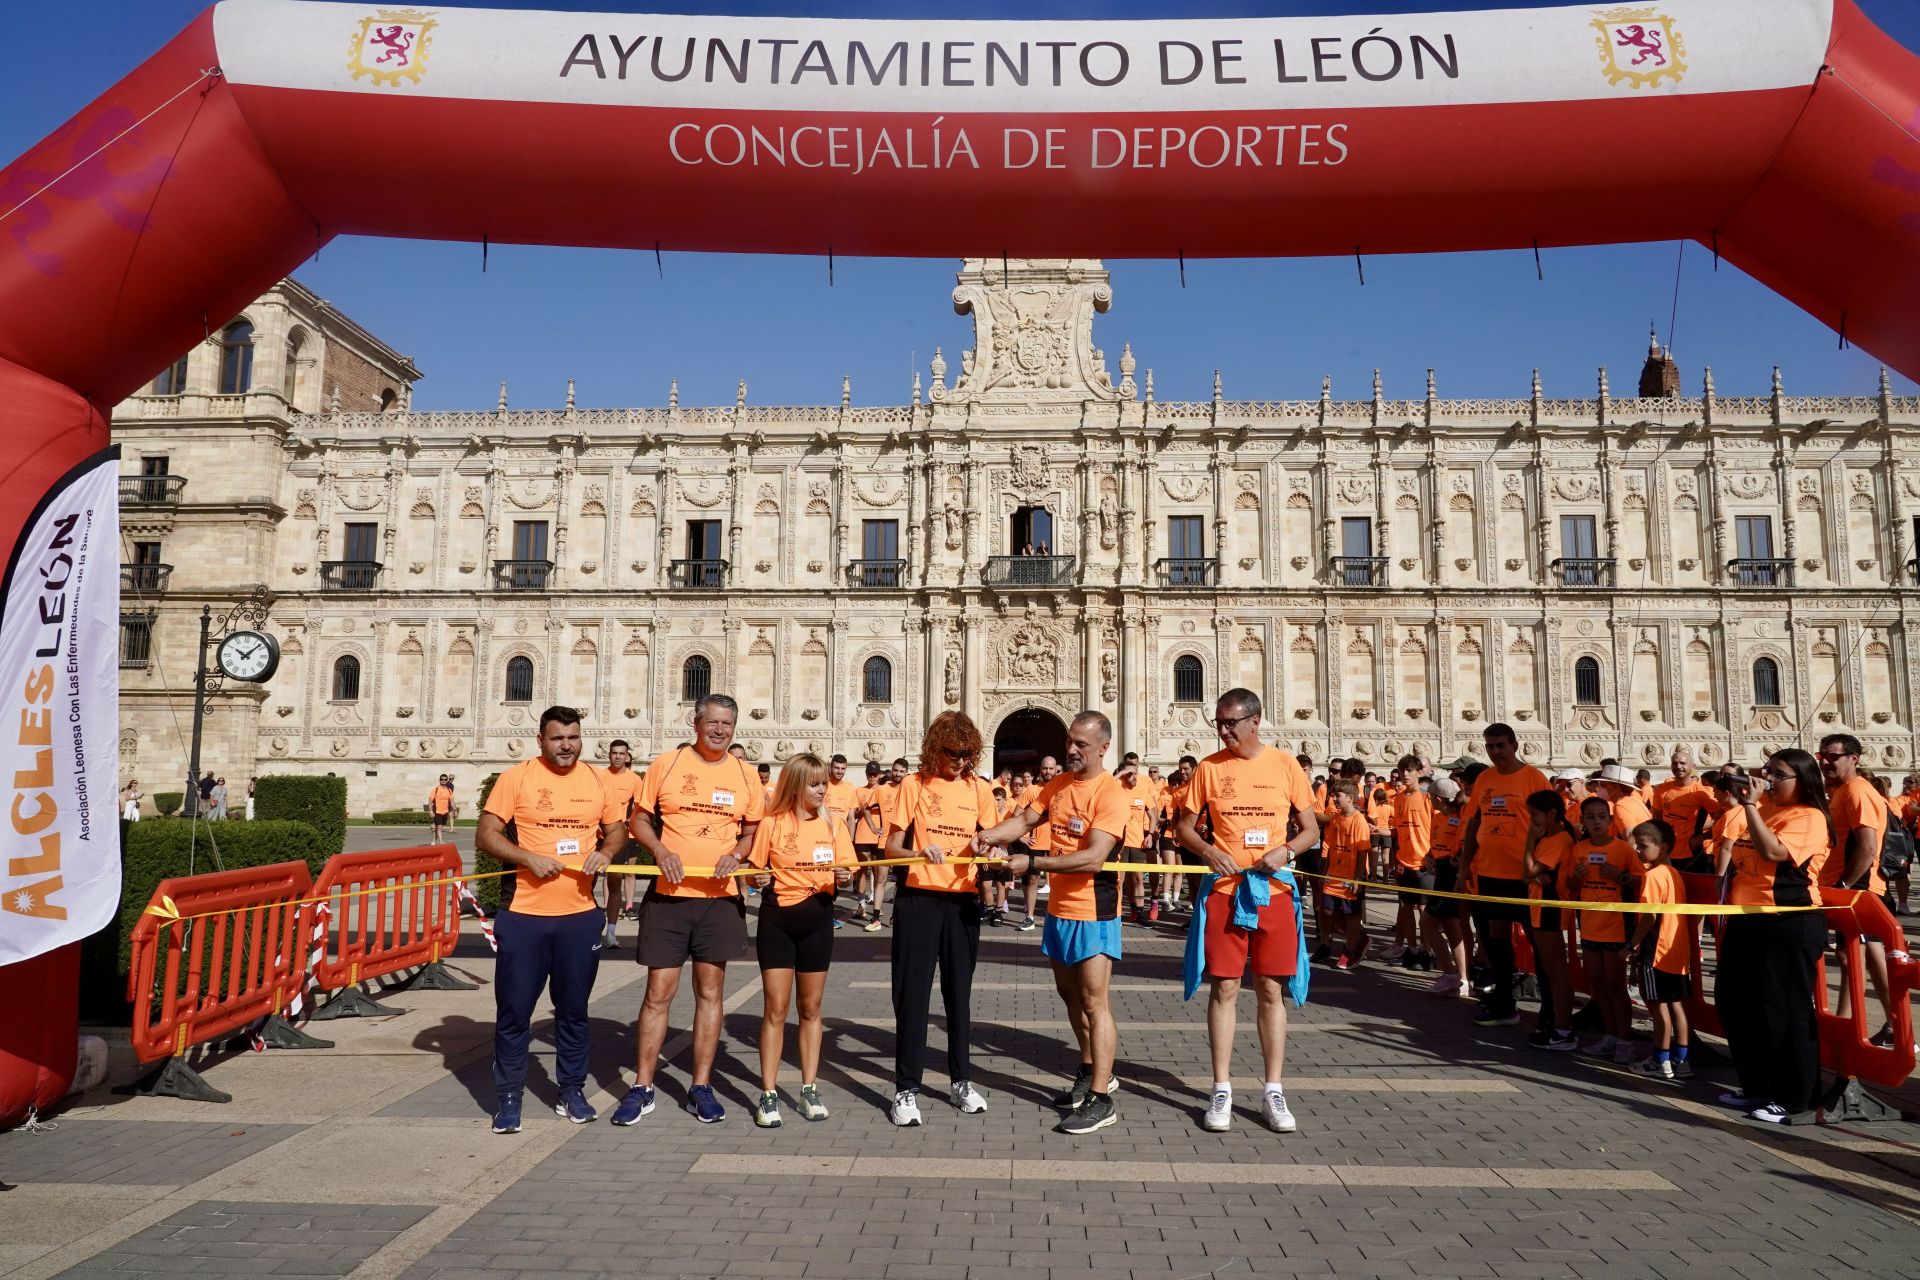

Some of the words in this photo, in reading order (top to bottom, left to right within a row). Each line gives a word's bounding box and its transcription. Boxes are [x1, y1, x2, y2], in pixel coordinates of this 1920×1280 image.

[559, 33, 1130, 87] AYUNTAMIENTO
[1159, 39, 1247, 85] DE
[1274, 27, 1459, 83] LEÓN
[669, 115, 980, 175] CONCEJALÍA
[1003, 128, 1066, 169] DE
[1091, 123, 1348, 169] DEPORTES
[77, 568, 84, 583] de
[78, 554, 87, 565] la
[67, 586, 81, 673] Enfermedades
[68, 676, 80, 697] Las
[69, 699, 80, 723] Con
[73, 725, 85, 775] Leonesa
[74, 776, 90, 841] Asociación
